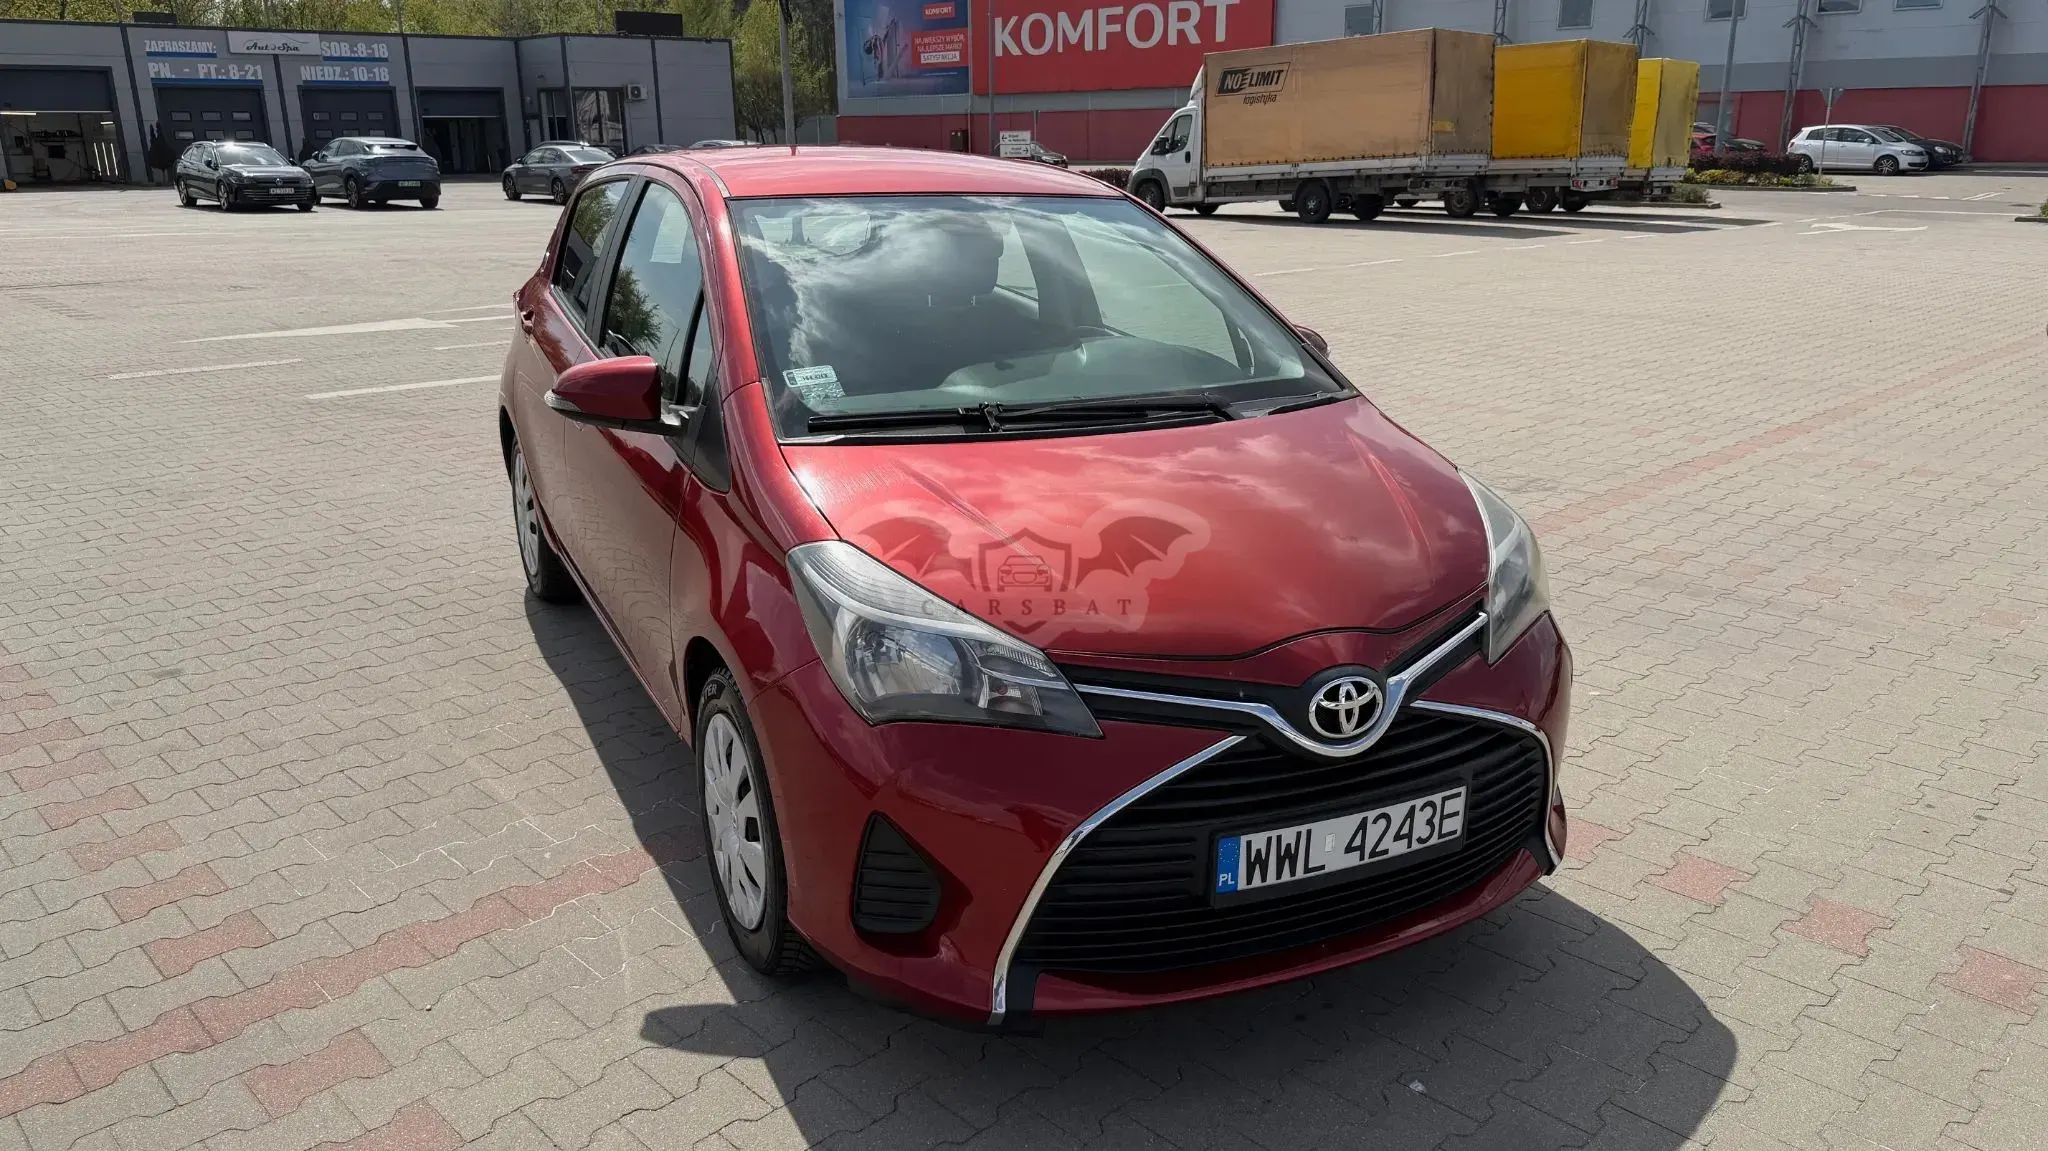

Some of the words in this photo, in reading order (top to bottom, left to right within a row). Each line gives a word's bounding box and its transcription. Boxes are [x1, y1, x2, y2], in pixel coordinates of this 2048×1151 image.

[925, 7, 952, 15] KOMFORT
[994, 0, 1240, 57] KOMFORT
[144, 40, 216, 53] ZAPRASZAMY:
[278, 42, 299, 52] Spa
[148, 62, 176, 79] PN.
[352, 66, 389, 81] 10-18
[1248, 70, 1284, 87] LIMIT
[1243, 93, 1278, 106] logistyka
[1245, 828, 1326, 886] WWL
[1344, 791, 1462, 862] 4243E
[1218, 872, 1235, 887] PL
